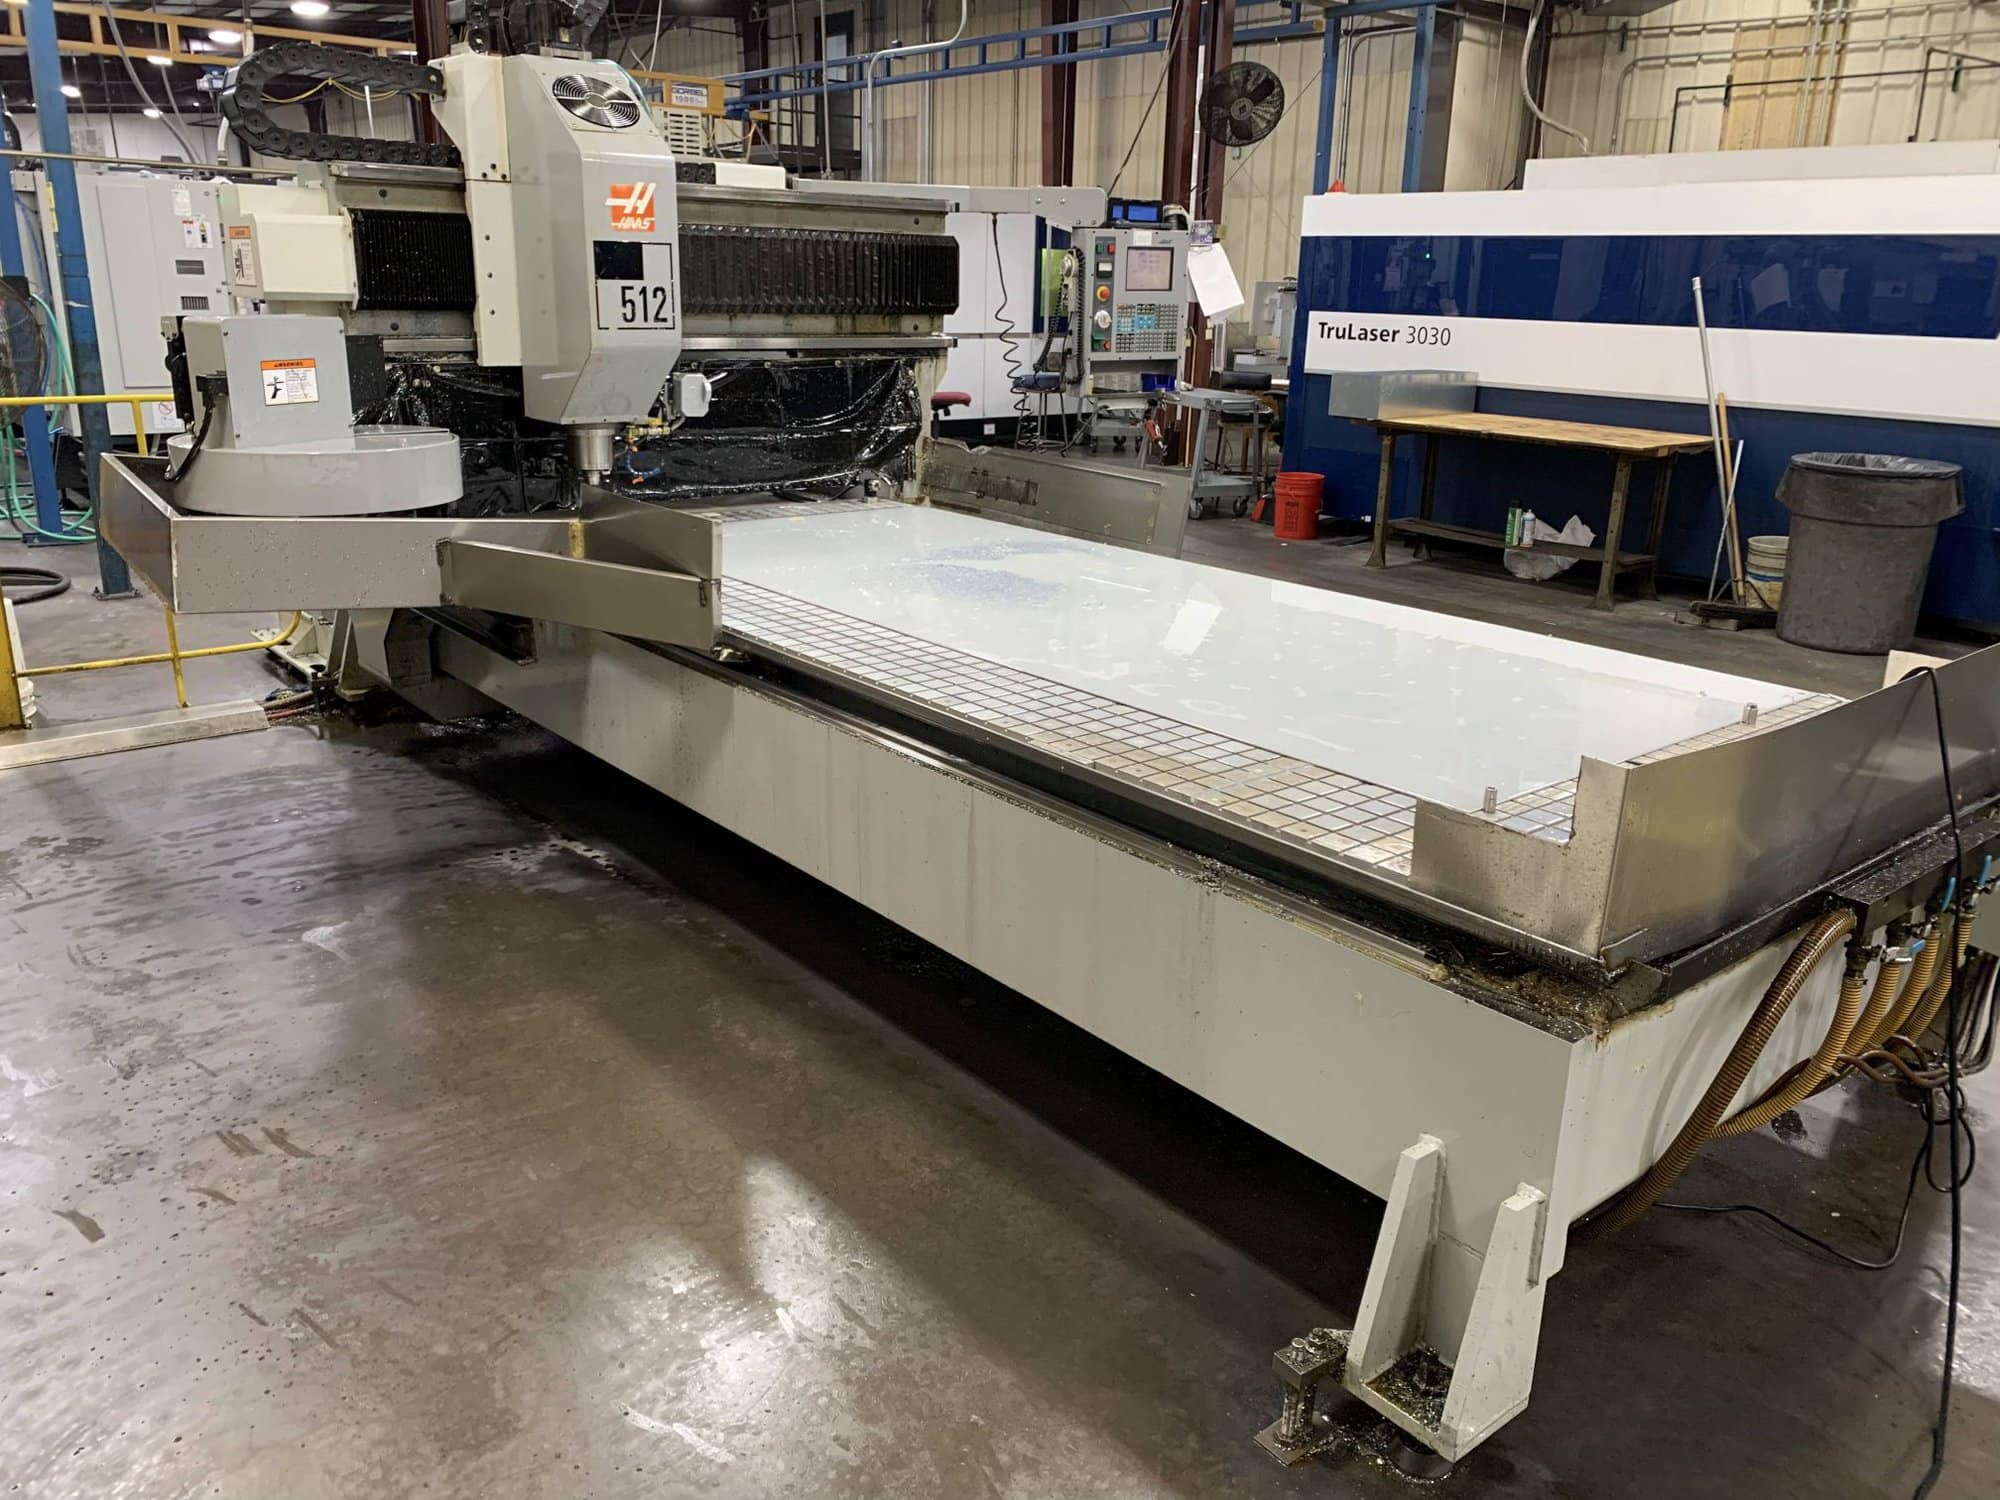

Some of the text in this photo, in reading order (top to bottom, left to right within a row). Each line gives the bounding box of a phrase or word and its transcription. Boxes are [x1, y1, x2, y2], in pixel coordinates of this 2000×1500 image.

[611, 216, 655, 230] HAAS
[621, 286, 667, 323] 512
[1318, 322, 1451, 346] TruLaser 3030
